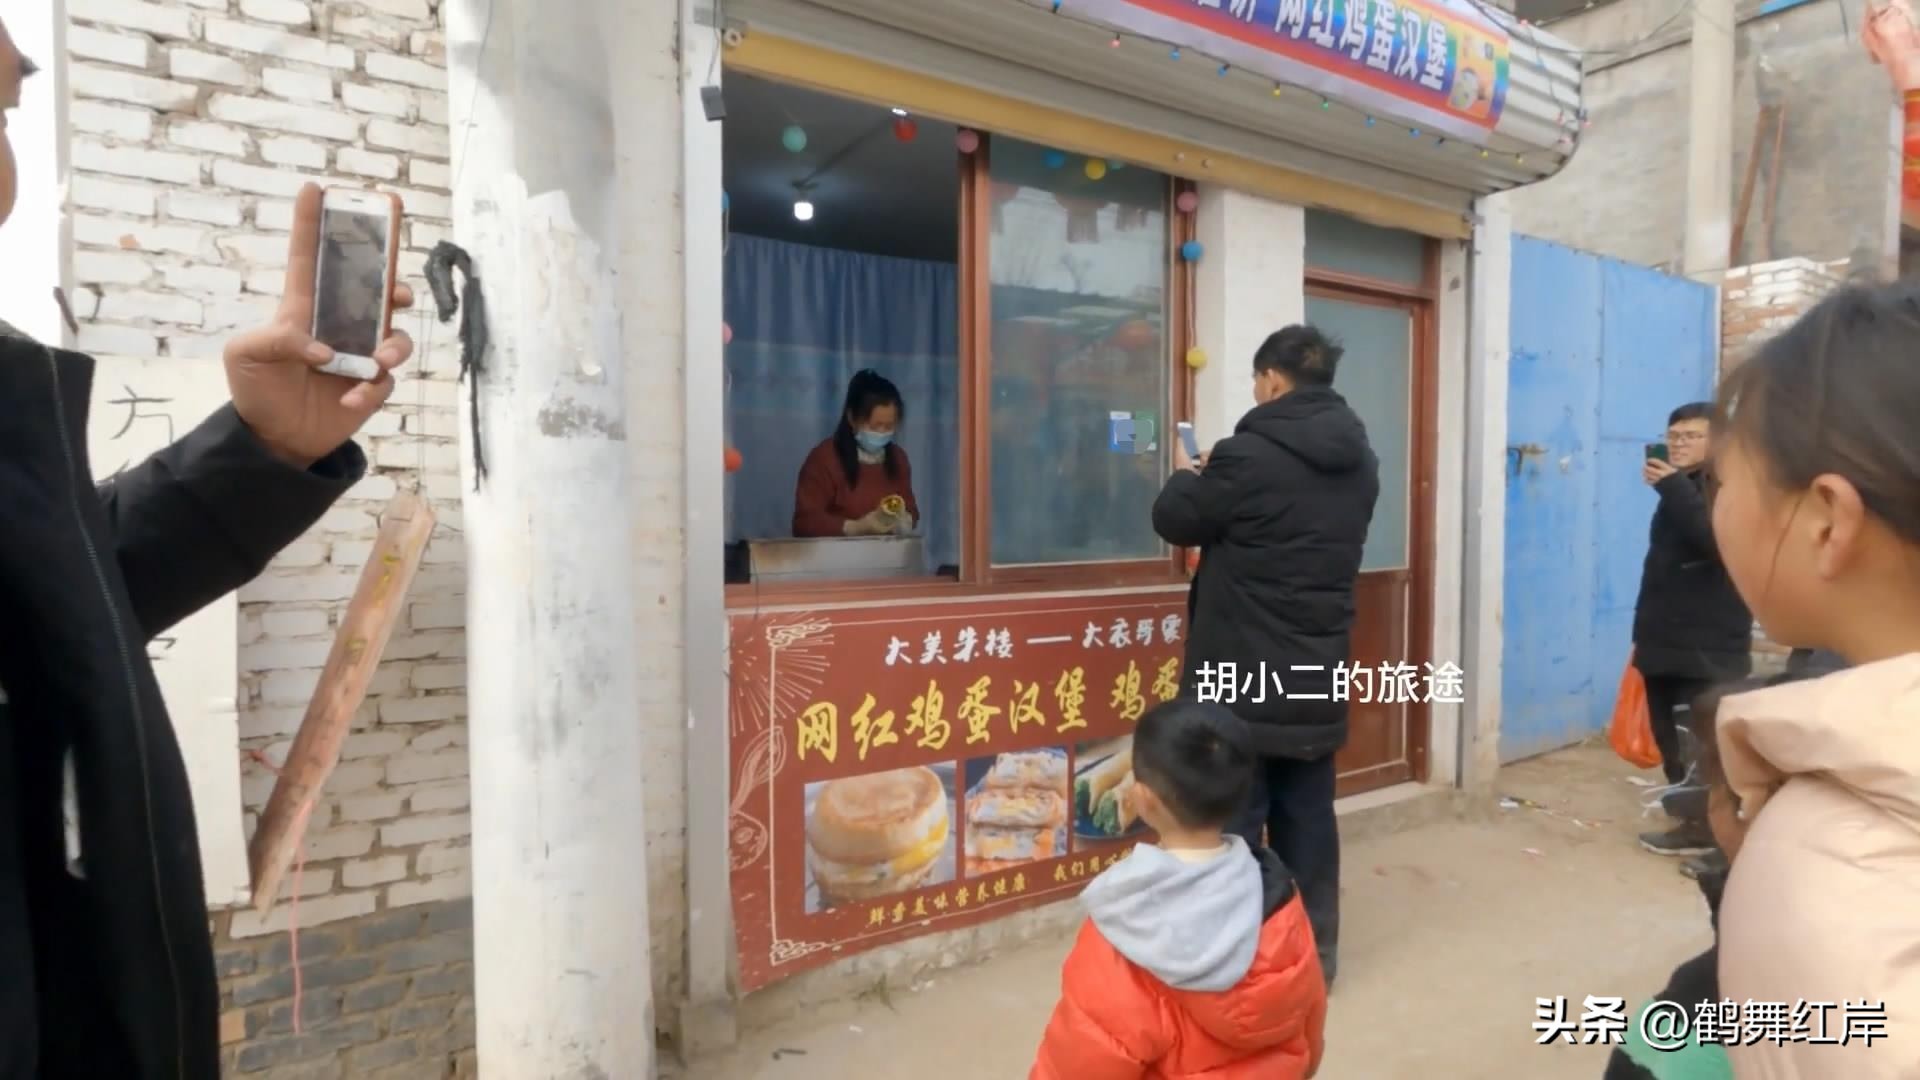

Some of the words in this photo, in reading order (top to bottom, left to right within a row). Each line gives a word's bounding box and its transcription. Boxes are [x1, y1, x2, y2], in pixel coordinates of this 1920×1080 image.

[106, 384, 174, 446] 方
[796, 666, 1088, 764] 网红鸡蛋汉堡
